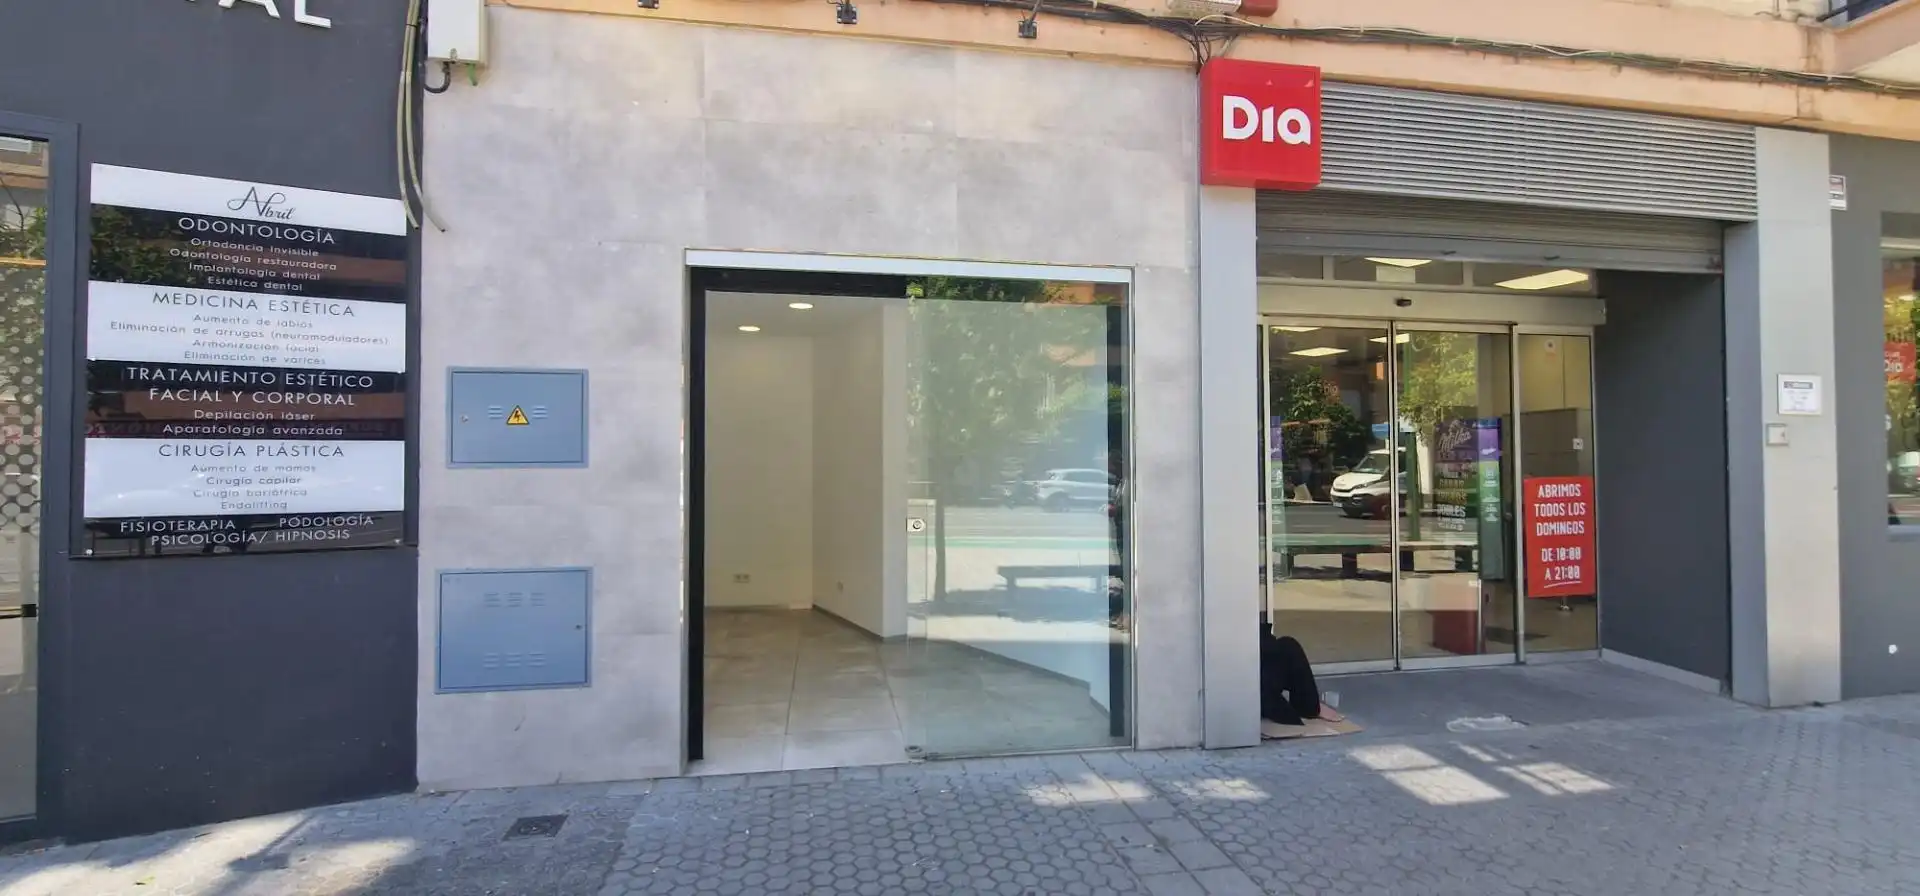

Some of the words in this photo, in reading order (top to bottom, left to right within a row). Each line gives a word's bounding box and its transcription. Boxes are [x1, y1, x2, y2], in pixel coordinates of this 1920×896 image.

[1223, 95, 1311, 145] Dia
[227, 186, 296, 220] Abril
[178, 217, 335, 244] ODONTOLOGÍA
[191, 237, 264, 252] Ortodoncia
[169, 248, 251, 265] Odontología
[257, 256, 337, 271] restauradora
[189, 263, 276, 279] Implantología
[282, 270, 321, 281] dental
[207, 276, 258, 288] Estética
[264, 278, 303, 291] dental
[152, 292, 258, 310] MEDICINA
[269, 299, 355, 317] ESTÉTICA
[193, 314, 249, 325] Aumento
[256, 317, 271, 326] de
[277, 319, 313, 328] labios
[110, 321, 186, 333] Eliminación
[193, 327, 209, 335] de
[215, 329, 265, 339] arrugas
[192, 339, 279, 350] Armonización
[184, 350, 255, 361] Eliminación
[262, 354, 277, 363] de
[127, 367, 276, 384] TRATAMIENTO
[285, 371, 373, 387] ESTÉTICO
[149, 388, 223, 402] FACIAL
[232, 391, 243, 403] Y
[252, 391, 355, 405] CORPORAL
[194, 409, 274, 420] Depilación
[281, 411, 316, 420] láser
[162, 424, 265, 436] Aparatología
[273, 426, 343, 435] avanzada
[159, 442, 246, 457] CIRUGÍA
[256, 442, 344, 457] PLÁSTICA
[191, 464, 247, 473] Aumento
[253, 464, 268, 473] de
[275, 465, 316, 473] mamas
[258, 477, 302, 486] capilar
[1537, 483, 1581, 498] ABRIMOS
[1534, 503, 1565, 517] TODOS
[1568, 502, 1586, 516] LOS
[120, 519, 236, 533] FISIOTERAPIA
[280, 514, 374, 528] PODOLOGÍA
[1536, 521, 1585, 536] DOMINGOS
[276, 529, 350, 541] HIPNOSIS
[1541, 548, 1554, 562] DE
[1556, 546, 1581, 562] 10:00
[1544, 567, 1552, 580] A
[1554, 565, 1580, 580] 21:00
